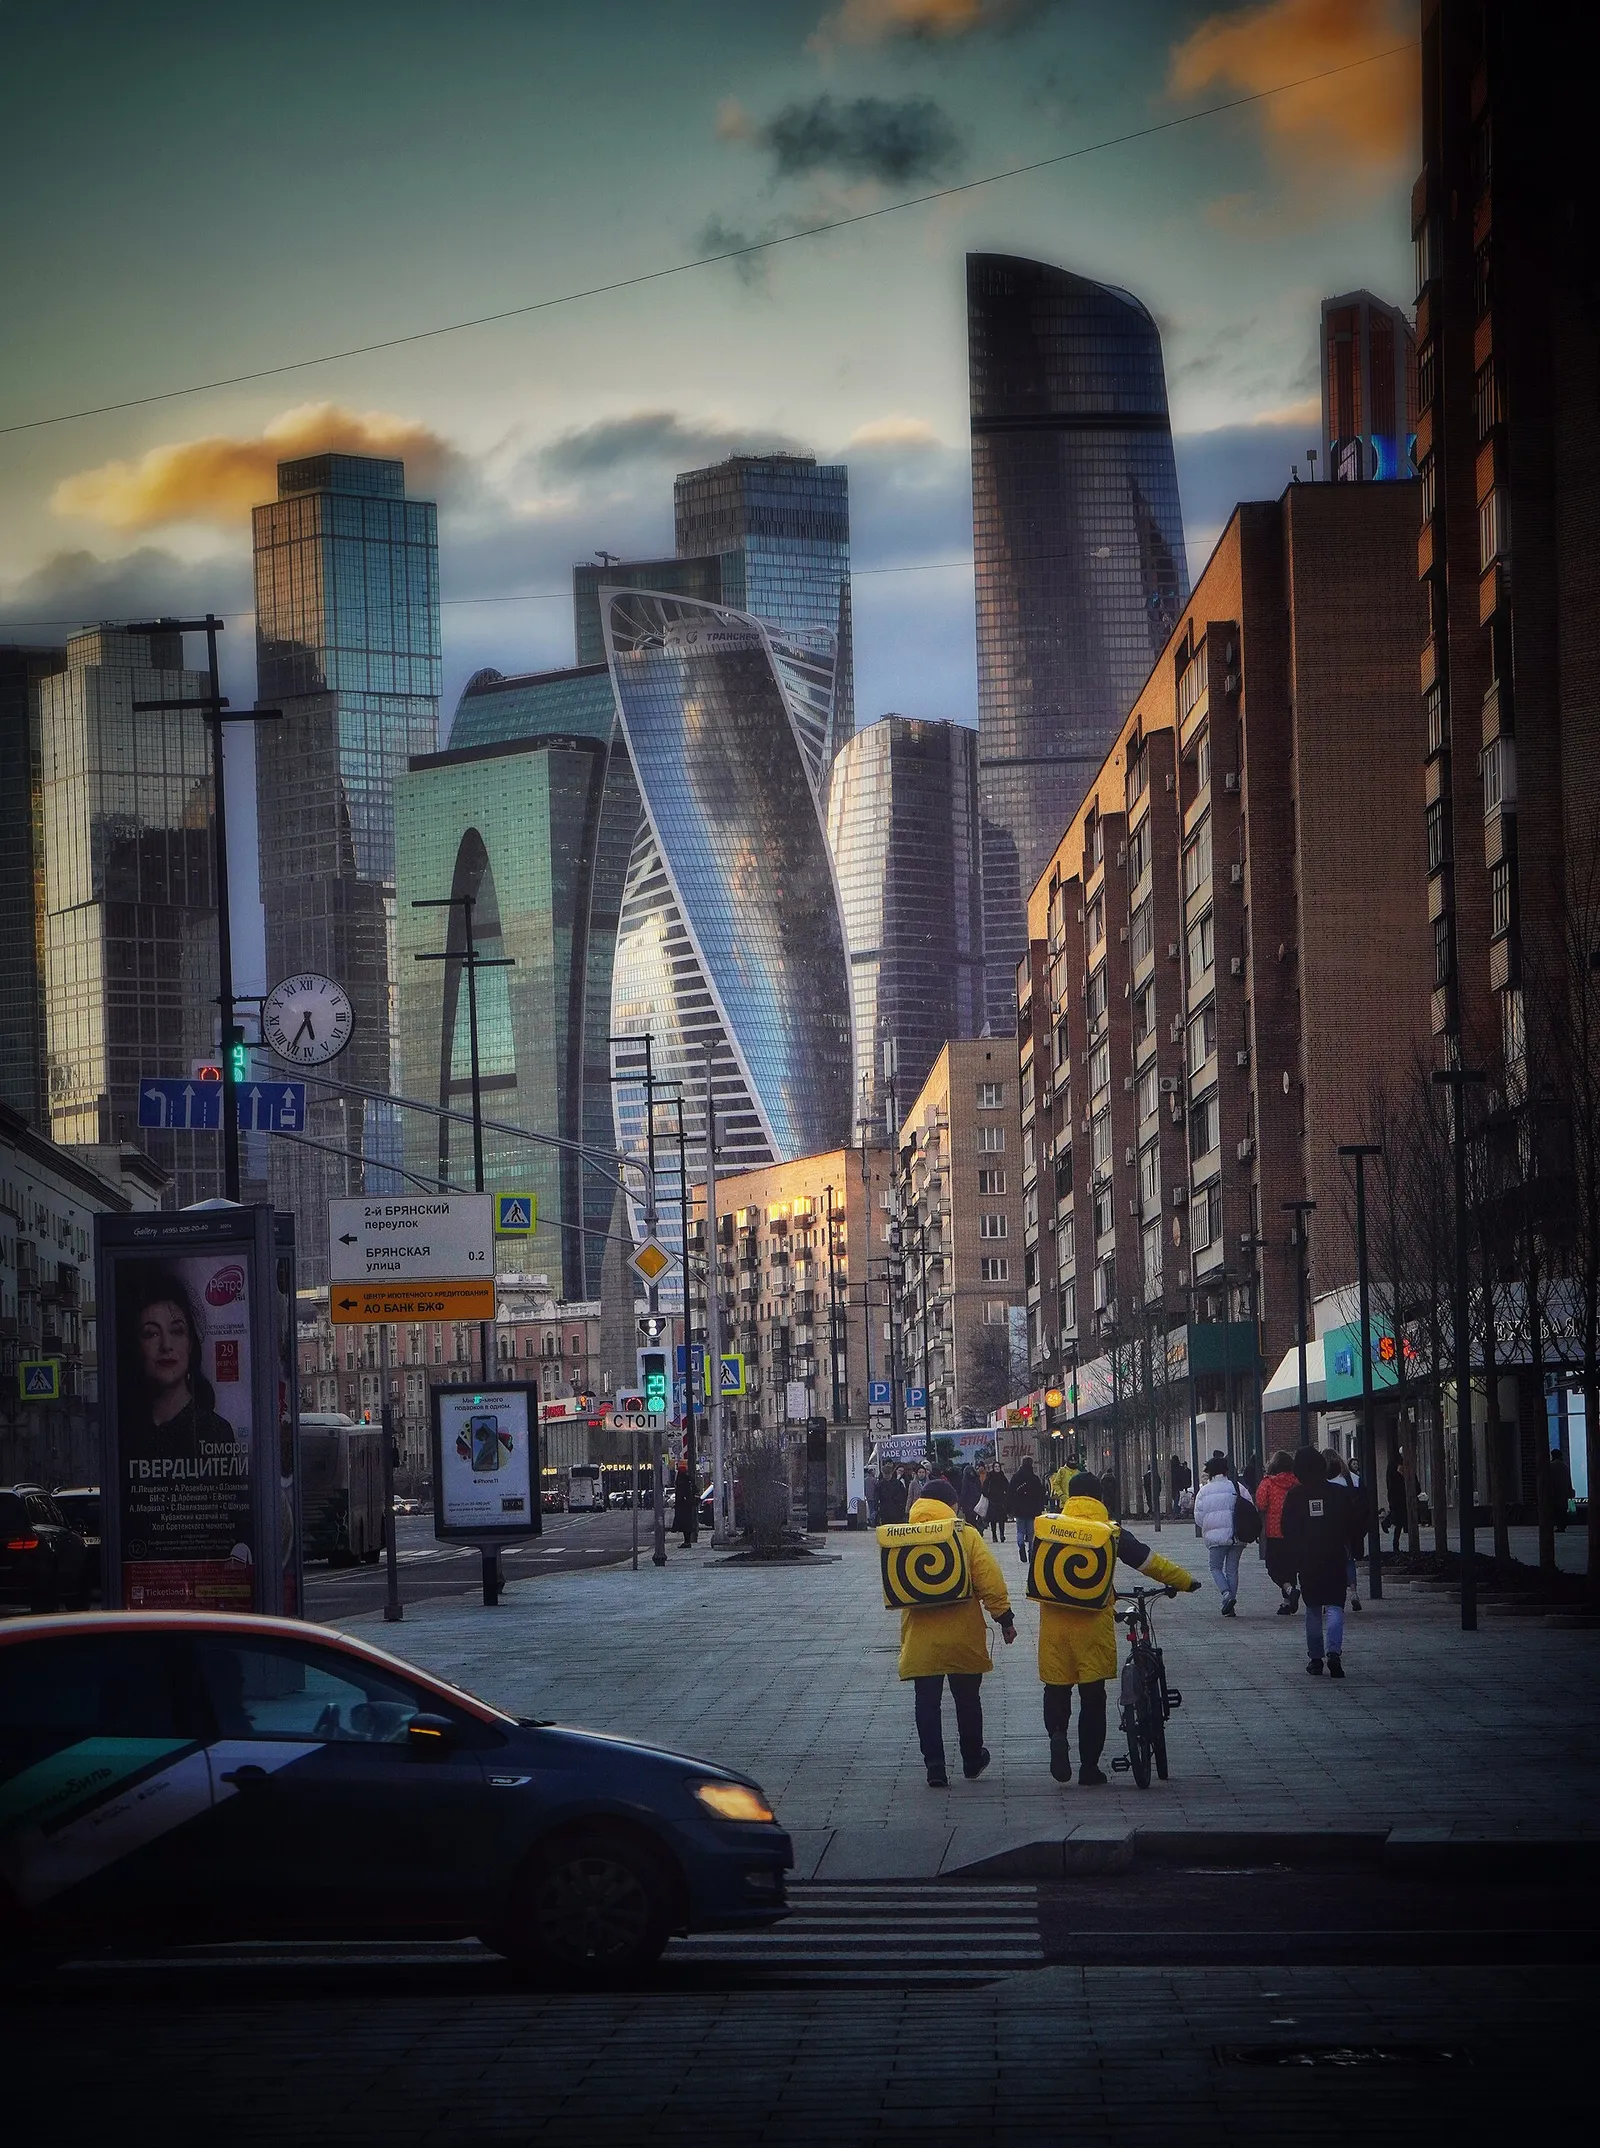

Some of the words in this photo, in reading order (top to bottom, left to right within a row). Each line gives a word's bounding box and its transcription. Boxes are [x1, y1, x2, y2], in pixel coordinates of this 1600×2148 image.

[300, 980, 312, 990] XII
[284, 984, 296, 998] XI
[272, 998, 284, 1008] X
[330, 996, 341, 1006] II
[336, 1012, 346, 1022] III
[364, 1206, 382, 1216] 2-й
[385, 1202, 450, 1216] БРЯНСКИЙ
[364, 1220, 418, 1230] переулок
[133, 1228, 158, 1237] Gallery
[366, 1246, 430, 1258] БРЯНСКАЯ
[468, 1251, 485, 1260] 0.2
[366, 1262, 401, 1272] улица
[210, 1278, 242, 1294] Ретро
[387, 1291, 433, 1299] ИПОТЕЧНОГО
[434, 1290, 489, 1298] КРЕДИТОВАНИЯ
[364, 1304, 380, 1314] АО
[384, 1303, 414, 1312] БАНК
[417, 1302, 445, 1312] БЖФ
[221, 1344, 234, 1357] 29
[613, 1414, 658, 1428] СТОП
[900, 1439, 928, 1448] POWER
[960, 1435, 990, 1446] STIHL
[198, 1440, 248, 1456] Тамара
[902, 1450, 912, 1458] BY
[129, 1457, 249, 1480] ГВЕРДЦИТЕЛИ
[150, 1494, 165, 1502] БИ-2
[160, 1513, 194, 1522] Кубанский
[152, 1523, 165, 1532] Хор
[166, 1522, 204, 1531] Сретенского
[886, 1526, 922, 1537] Яндекс
[1050, 1524, 1077, 1539] Яндекс
[1078, 1530, 1093, 1542] Еда
